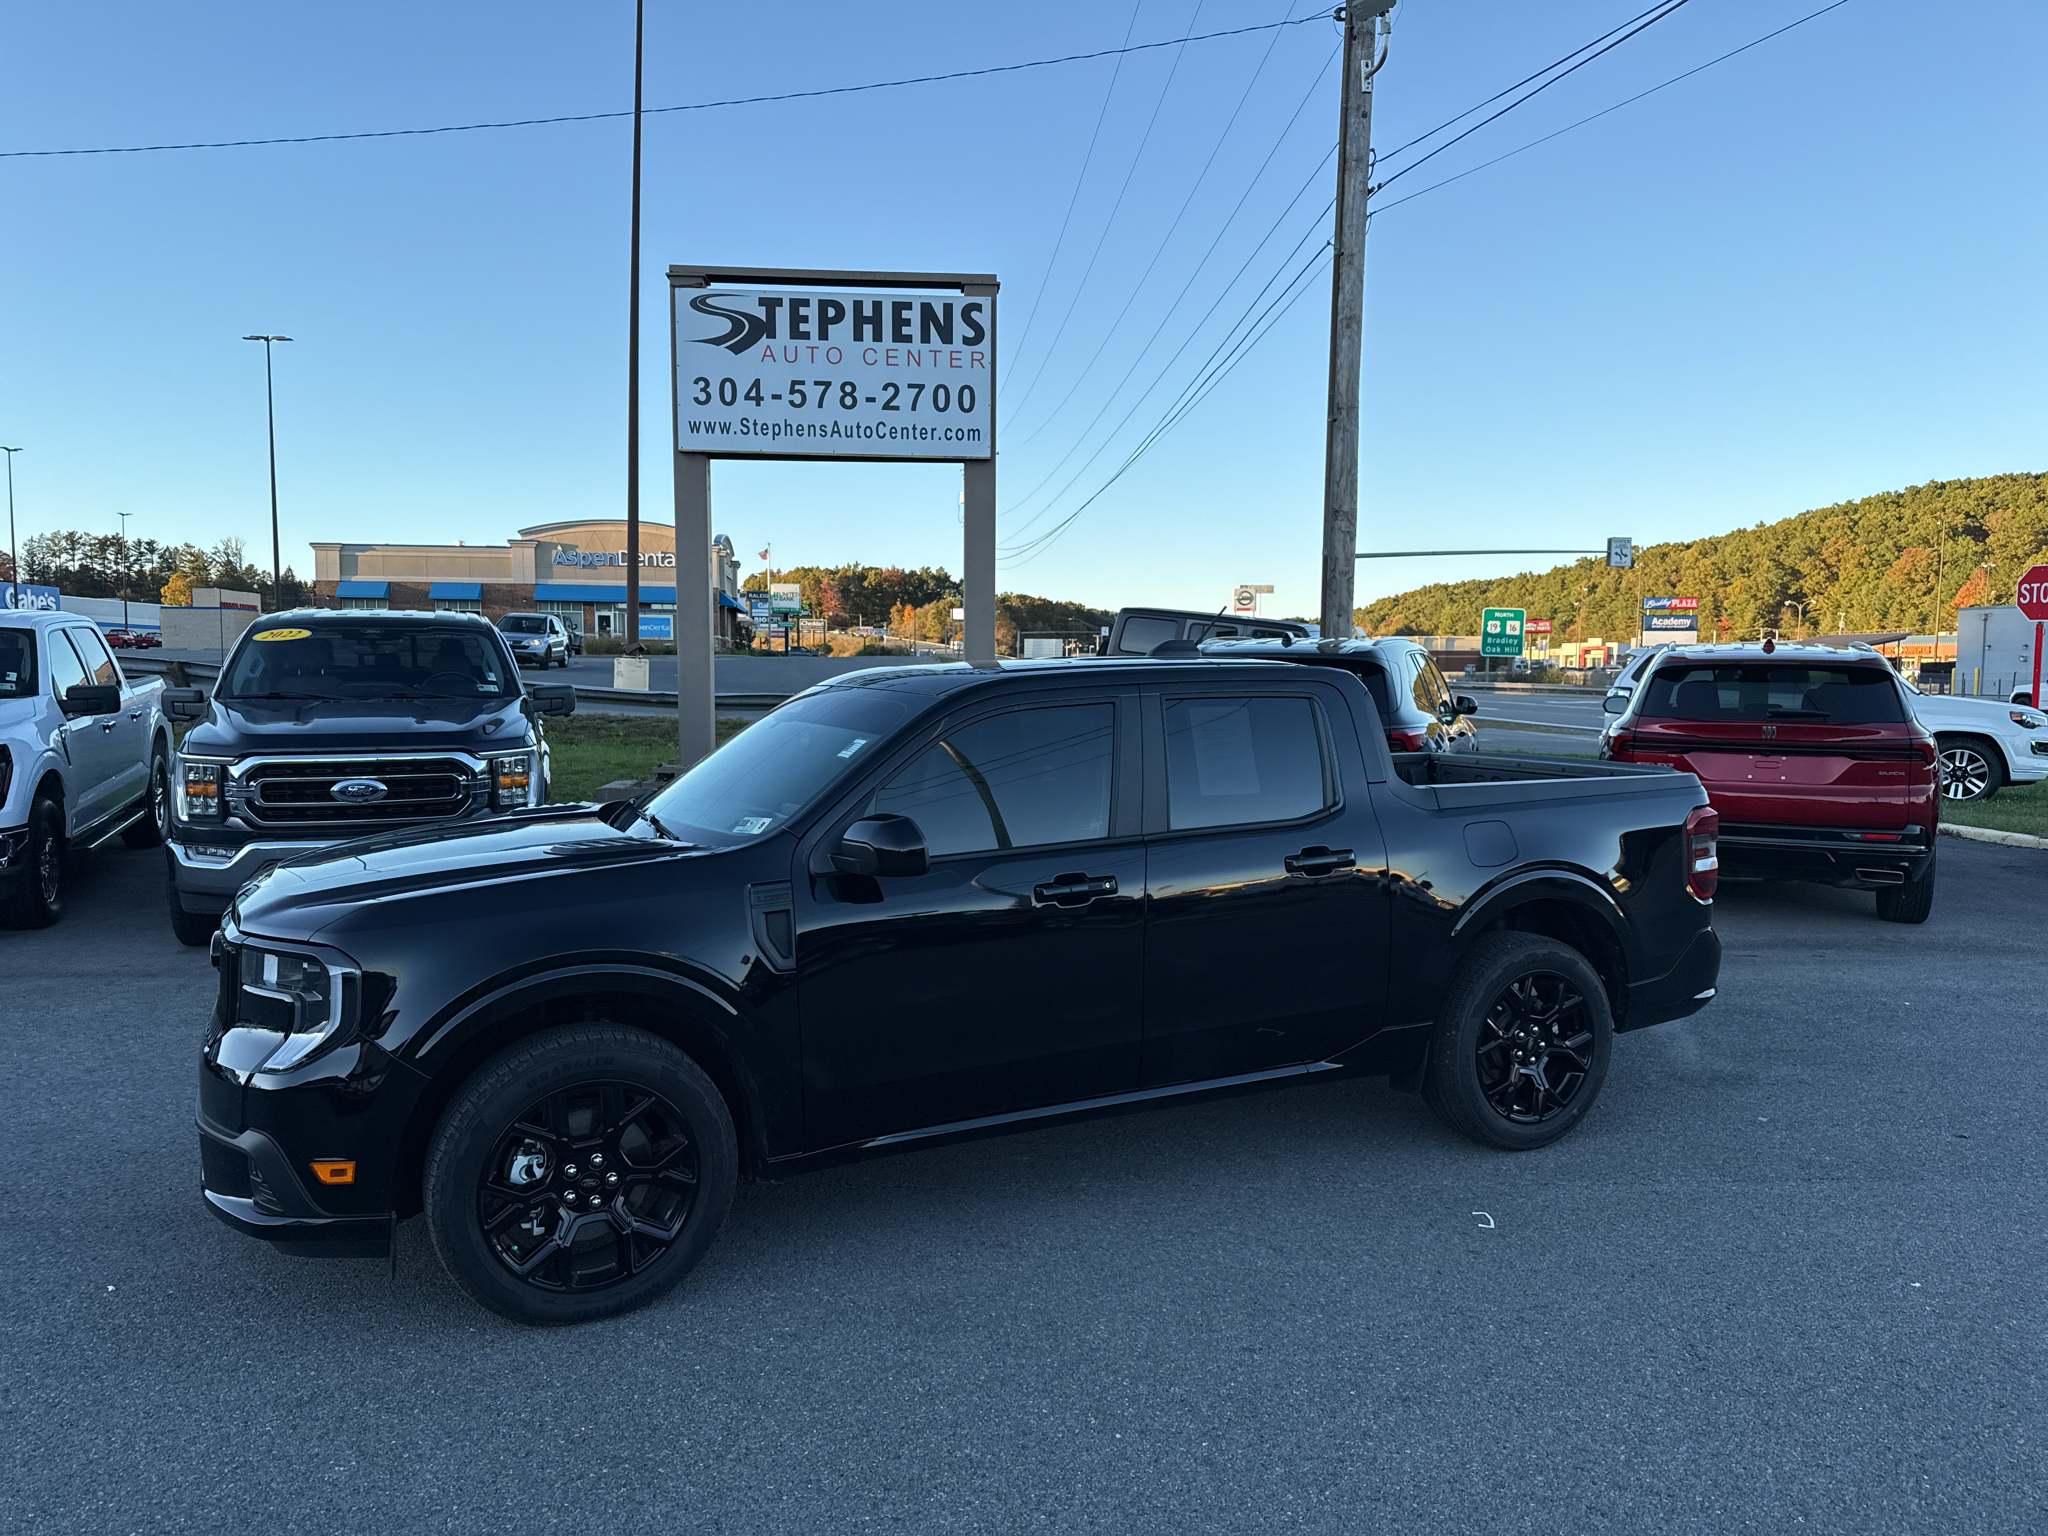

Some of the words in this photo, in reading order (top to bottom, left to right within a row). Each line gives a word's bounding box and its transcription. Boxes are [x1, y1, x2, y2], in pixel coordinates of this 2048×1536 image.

[684, 293, 987, 355] STEPHENS
[761, 344, 843, 366] AUTO
[862, 347, 986, 370] CENTER
[692, 376, 977, 414] 304-578-2700
[688, 417, 982, 442] www.StephensAutoCenter.com
[552, 545, 676, 569] AspenDenta
[2019, 583, 2048, 604] STO
[1671, 599, 1698, 608] PLAZA
[639, 624, 670, 632] penDental
[1489, 623, 1498, 631] 19
[1509, 624, 1517, 632] 16
[1651, 617, 1692, 628] Academy
[260, 630, 303, 640] 2022
[1486, 637, 1519, 645] Bradley
[346, 785, 373, 796] Ford
[525, 1056, 615, 1089] WRANGLER
